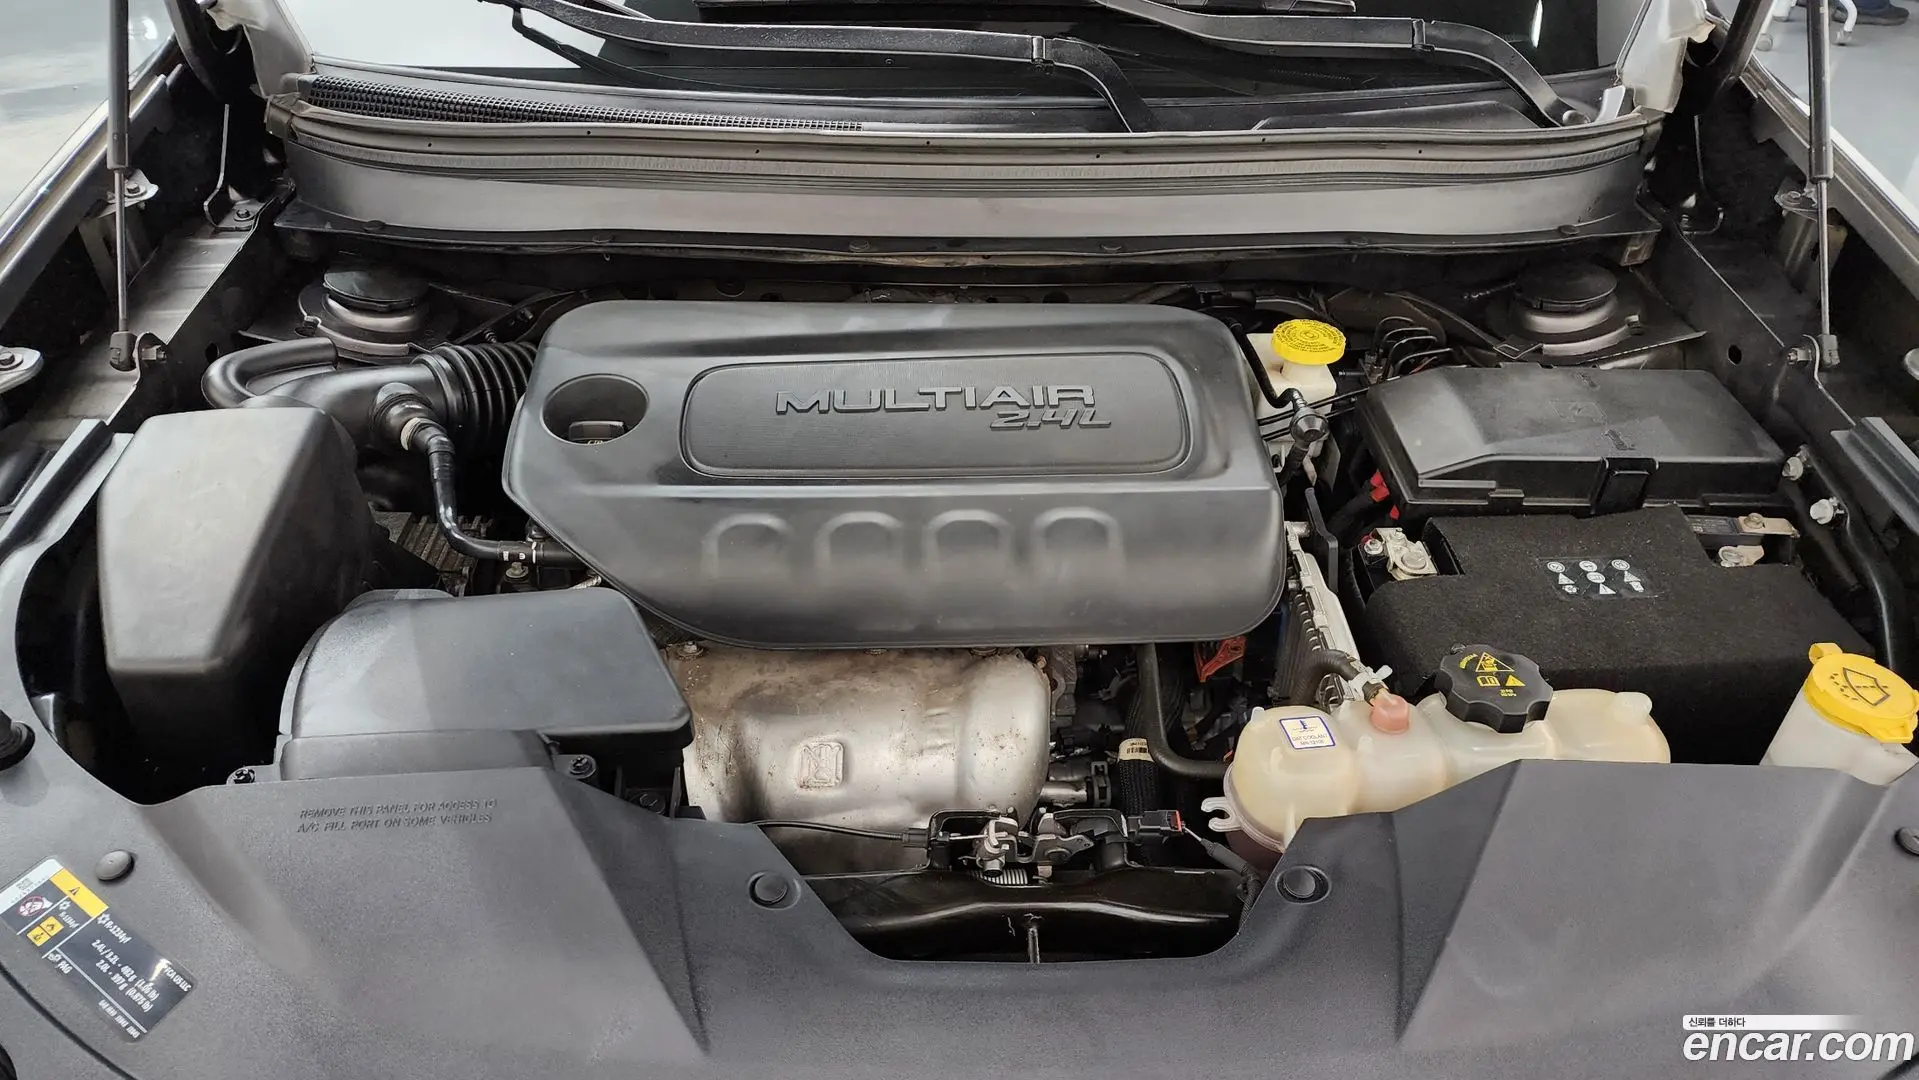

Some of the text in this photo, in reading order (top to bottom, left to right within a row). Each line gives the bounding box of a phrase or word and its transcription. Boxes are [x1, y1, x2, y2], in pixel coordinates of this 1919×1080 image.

[776, 385, 1095, 414] MULTIAIR
[990, 408, 1111, 431] 2.4L
[300, 807, 347, 819] REMOVE
[376, 802, 411, 815] PANEL
[413, 800, 435, 812] FOR
[438, 799, 480, 811] ACCESS
[297, 813, 493, 833] A/C FILL PORT ON SOME VEHICLES
